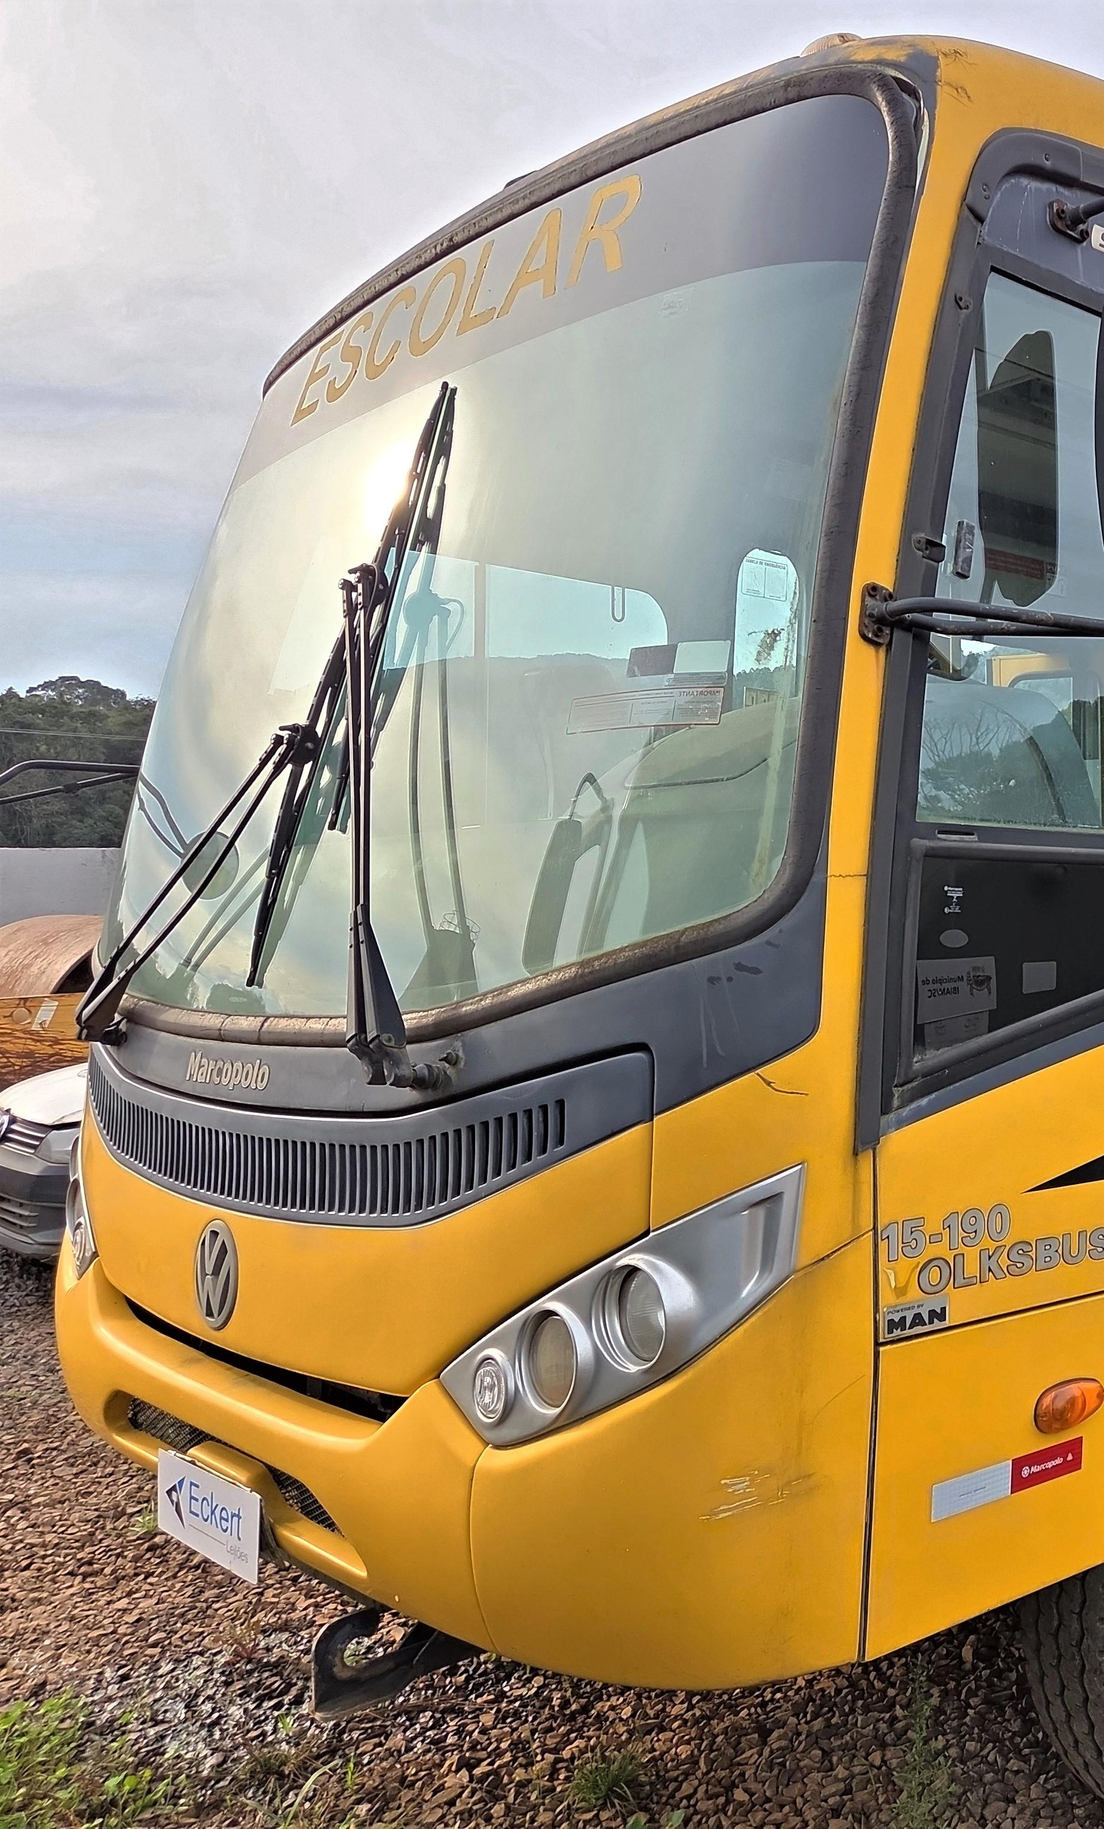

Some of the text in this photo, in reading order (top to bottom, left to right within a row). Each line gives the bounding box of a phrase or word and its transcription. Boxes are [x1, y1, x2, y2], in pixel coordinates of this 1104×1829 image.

[290, 173, 643, 428] ESCOLAR
[185, 1051, 270, 1091] Marcopolo
[881, 1203, 1012, 1263] 15-190
[887, 1305, 916, 1316] POWERED
[887, 1306, 947, 1335] MAN
[1030, 1456, 1064, 1474] Marcopolo
[188, 1480, 243, 1542] Eckert
